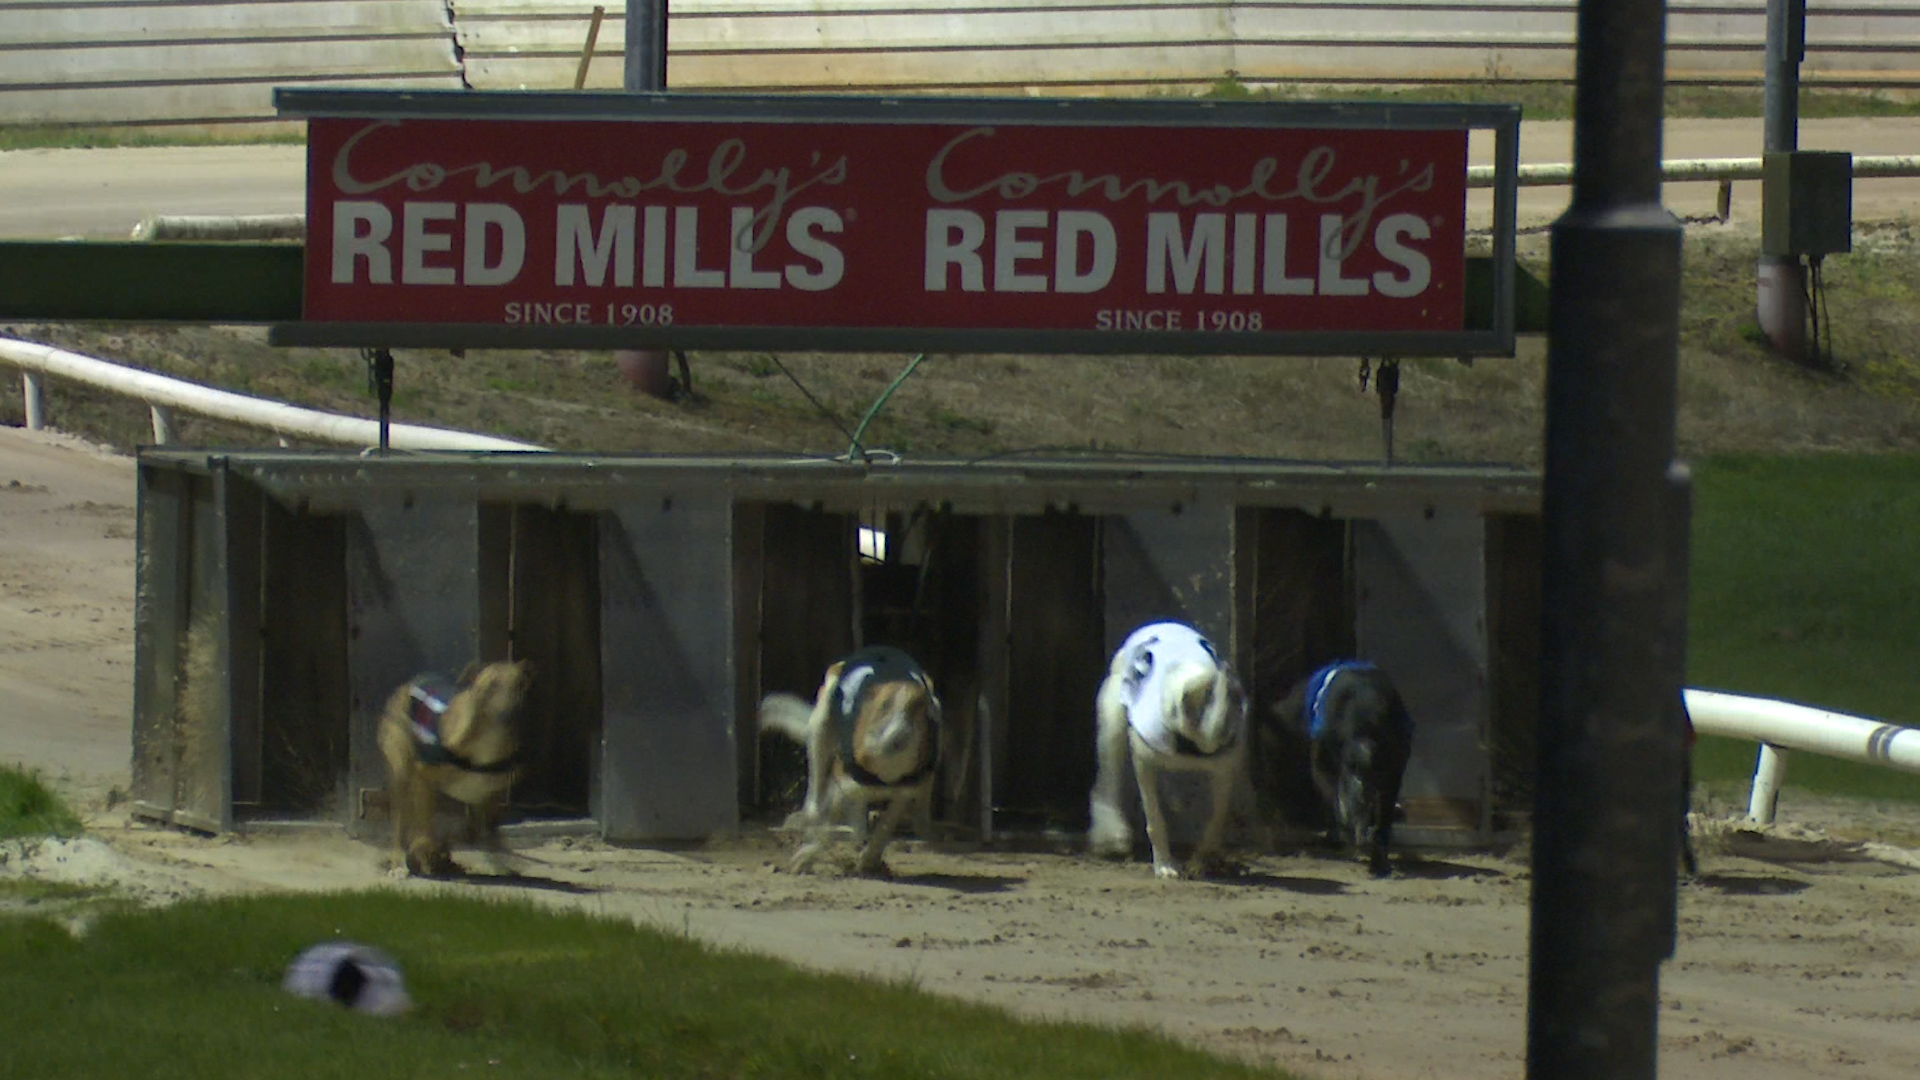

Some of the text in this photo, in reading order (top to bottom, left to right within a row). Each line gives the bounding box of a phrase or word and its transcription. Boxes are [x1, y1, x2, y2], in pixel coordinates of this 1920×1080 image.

[332, 119, 848, 253] Connolly's
[925, 126, 1435, 261] Connolly's
[331, 200, 845, 291] RED MILLS
[925, 208, 1432, 299] RED MILLS
[504, 302, 674, 327] SINCE 1908
[1095, 309, 1264, 333] SINCE 1908
